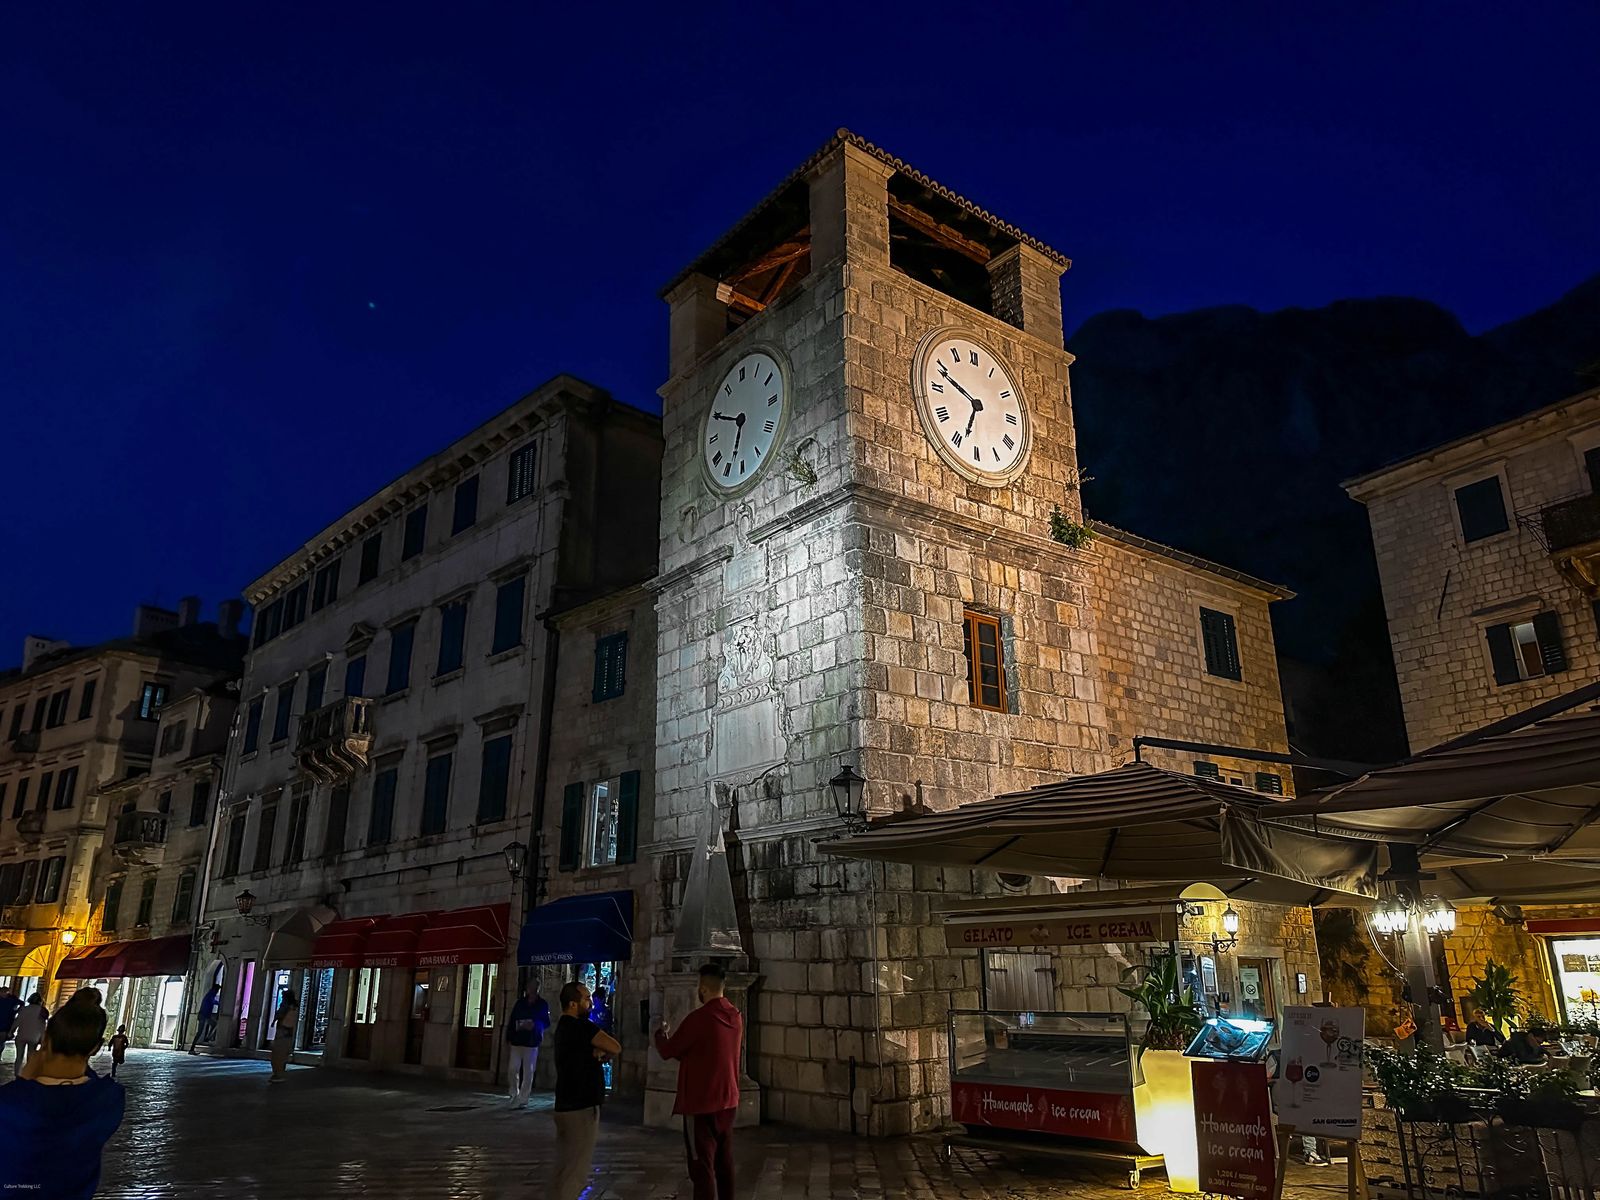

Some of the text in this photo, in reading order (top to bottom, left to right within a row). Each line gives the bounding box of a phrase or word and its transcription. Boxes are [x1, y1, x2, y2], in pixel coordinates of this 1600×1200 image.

[1005, 413, 1017, 426] III
[963, 926, 1014, 943] GELATO
[1066, 920, 1154, 940] ICE CREAM
[433, 955, 450, 965] BANKA
[557, 953, 573, 961] PRESS
[982, 1091, 1101, 1123] Homemade ice cream
[1200, 1112, 1267, 1143] Homemade
[1207, 1141, 1264, 1162] ice cream
